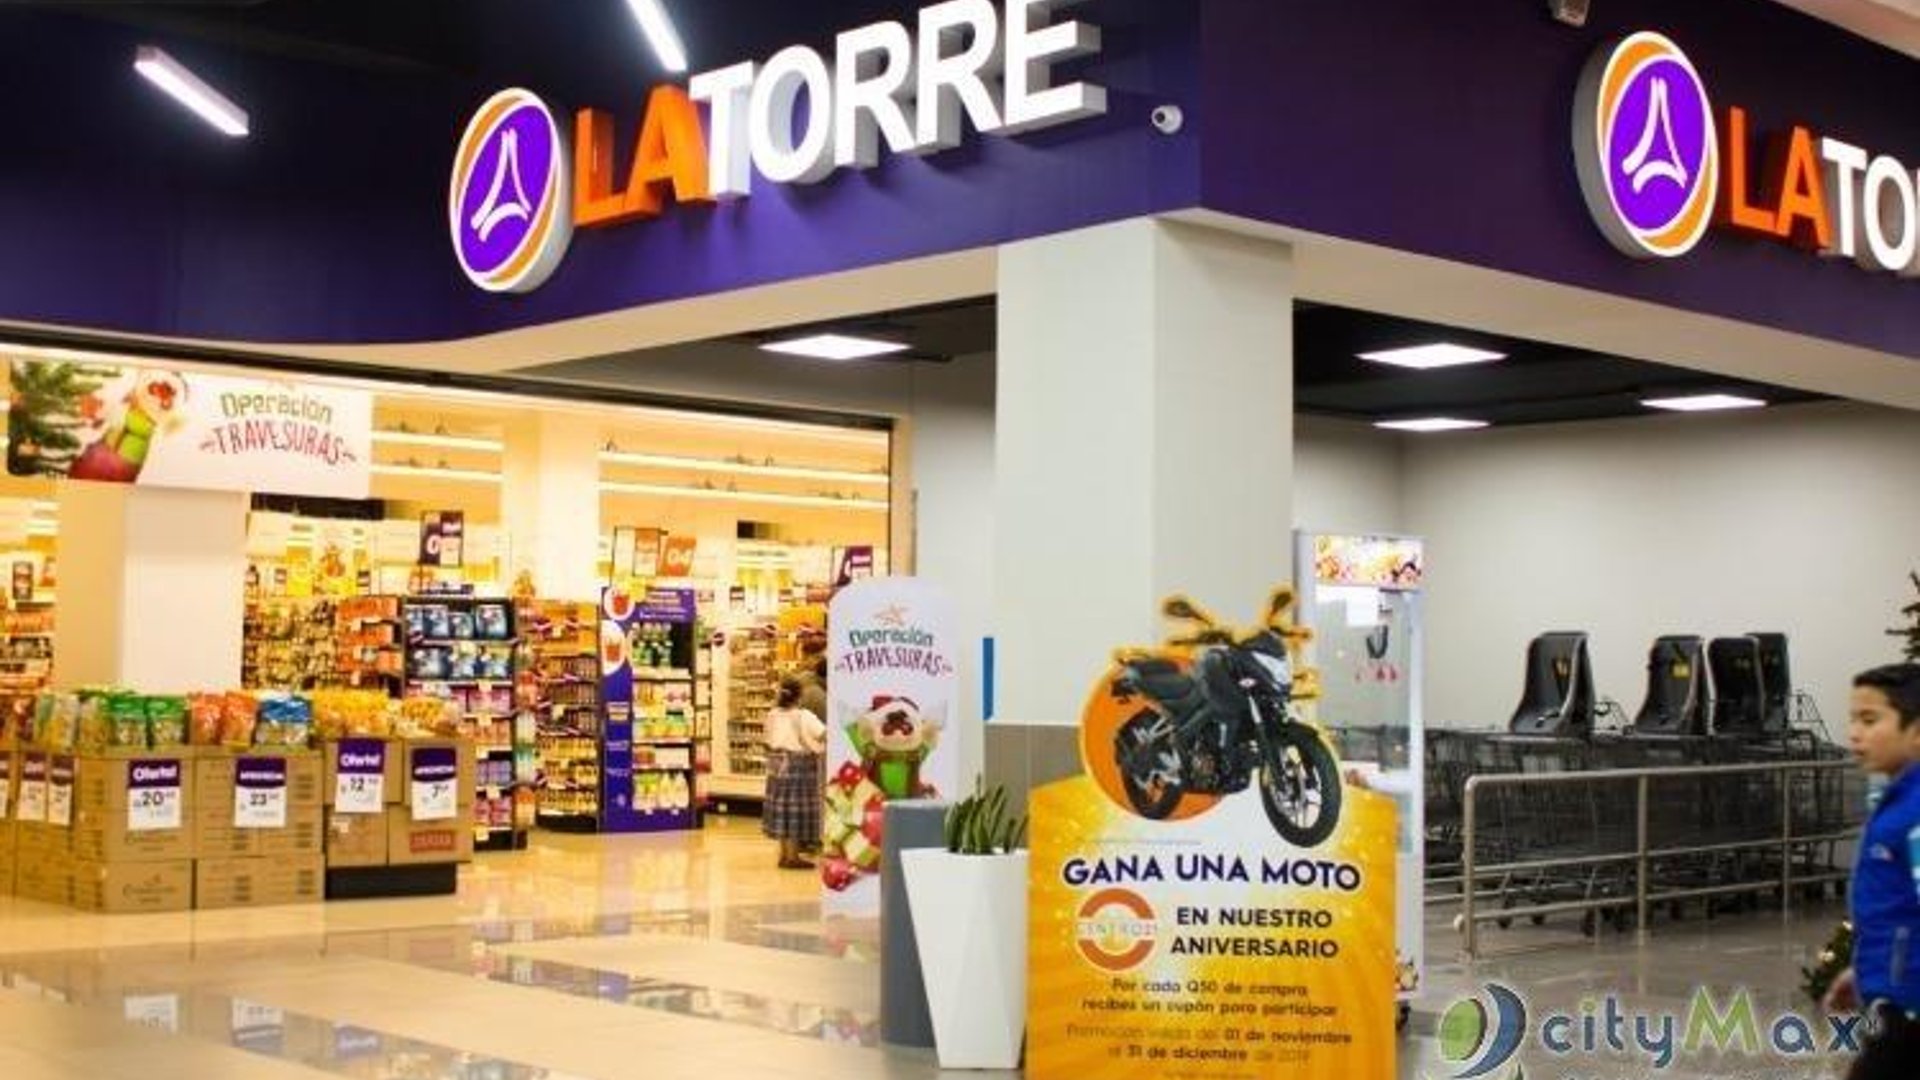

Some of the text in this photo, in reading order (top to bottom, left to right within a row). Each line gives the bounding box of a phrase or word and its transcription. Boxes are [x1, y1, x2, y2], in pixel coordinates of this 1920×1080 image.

[844, 647, 943, 675] TRAVESURAS
[1063, 854, 1361, 891] GANA UNA MOTO
[1177, 907, 1333, 929] EN NUESTRO
[1171, 936, 1339, 958] ANIVERSARIO
[1112, 978, 1307, 998] Por cada Q50 de compra
[1082, 997, 1136, 1010] recibes
[1143, 1000, 1161, 1011] un
[1220, 1002, 1256, 1015] para
[1262, 1002, 1337, 1017] participar
[1246, 1029, 1265, 1041] de
[1272, 1030, 1352, 1044] noviembre
[1147, 1047, 1167, 1059] de
[1172, 1047, 1247, 1061] diciembre
